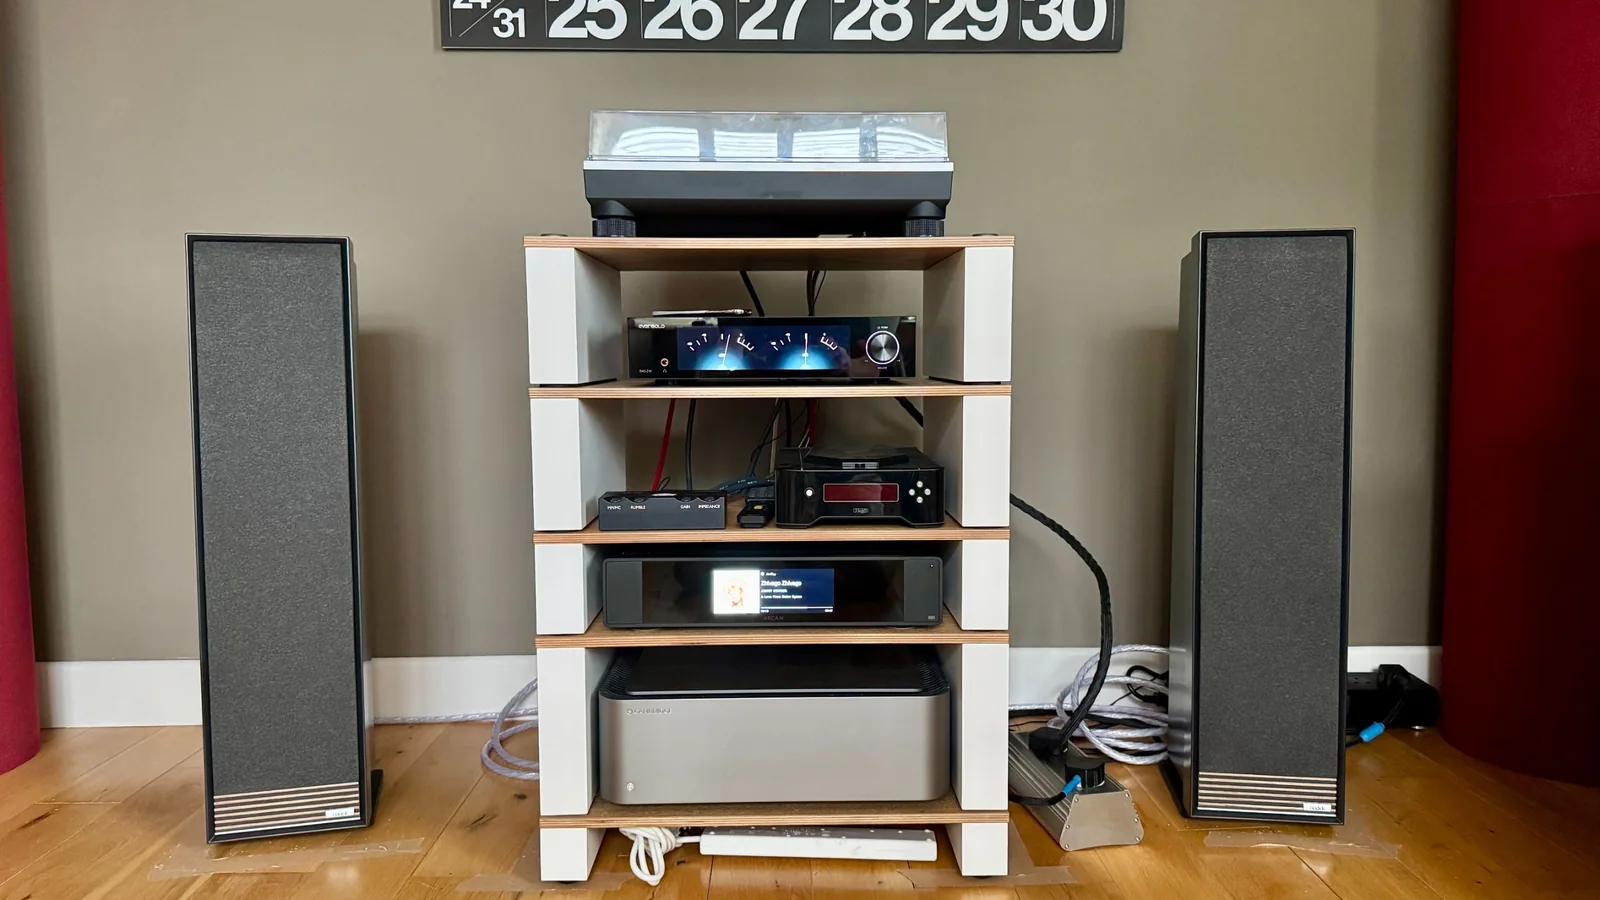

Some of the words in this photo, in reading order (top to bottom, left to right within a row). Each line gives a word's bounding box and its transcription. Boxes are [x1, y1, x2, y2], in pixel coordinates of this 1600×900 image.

[492, 7, 526, 38] 31
[548, 0, 628, 40] 25
[643, 0, 724, 41] 26
[738, 0, 808, 40] 27
[832, 0, 914, 42] 28
[927, 0, 1009, 42] 29
[1021, 0, 1108, 42] 30
